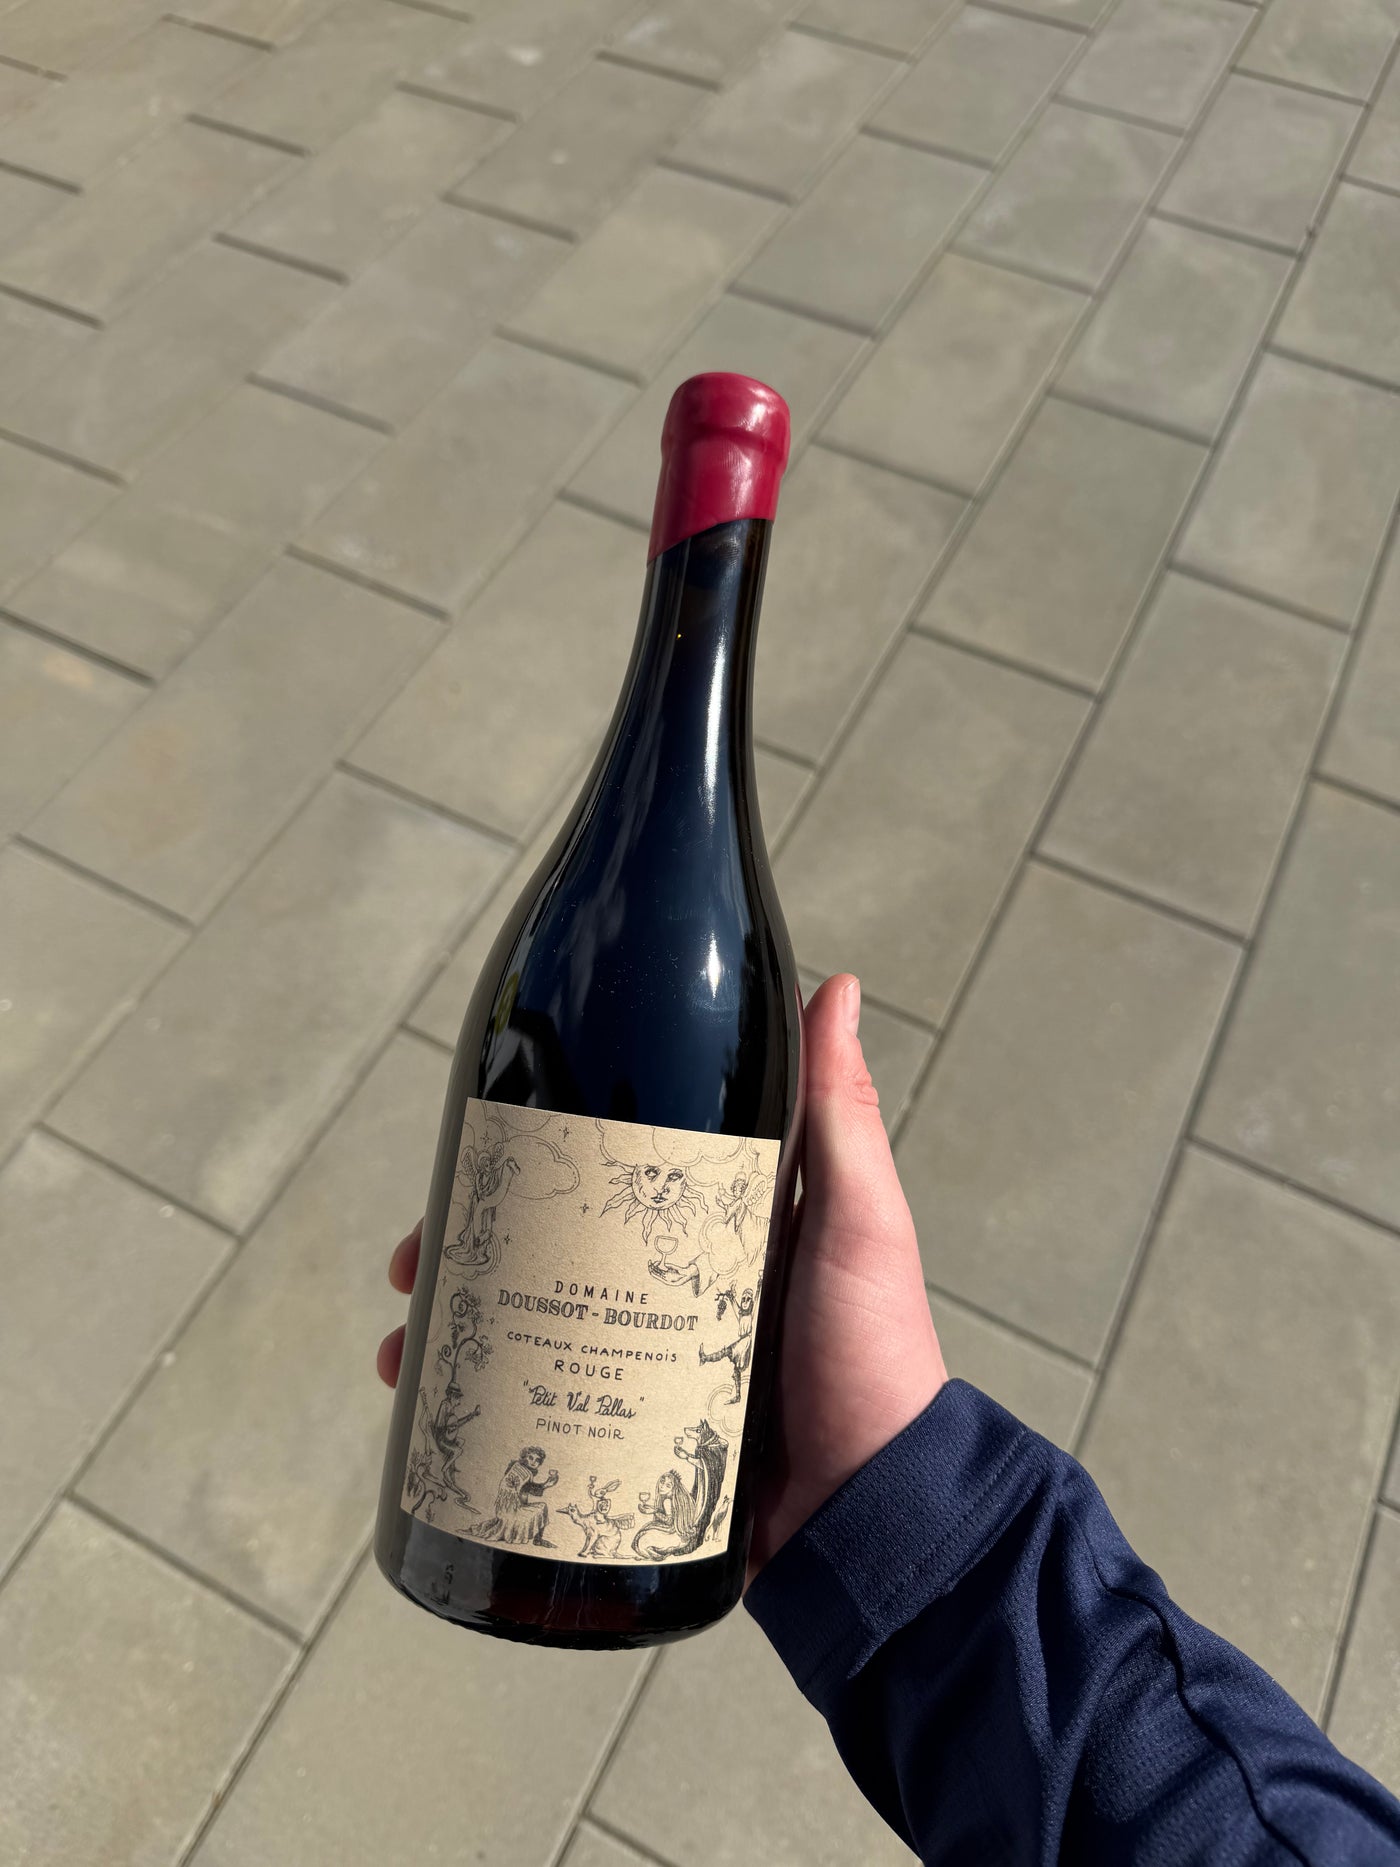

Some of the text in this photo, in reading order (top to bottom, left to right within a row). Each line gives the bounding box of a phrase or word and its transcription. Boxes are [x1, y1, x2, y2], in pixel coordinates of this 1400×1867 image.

[554, 1280, 649, 1305] DOMAINE
[507, 1331, 572, 1351] COTEAUX
[554, 1359, 624, 1381] ROUGE
[567, 1390, 589, 1413] Val
